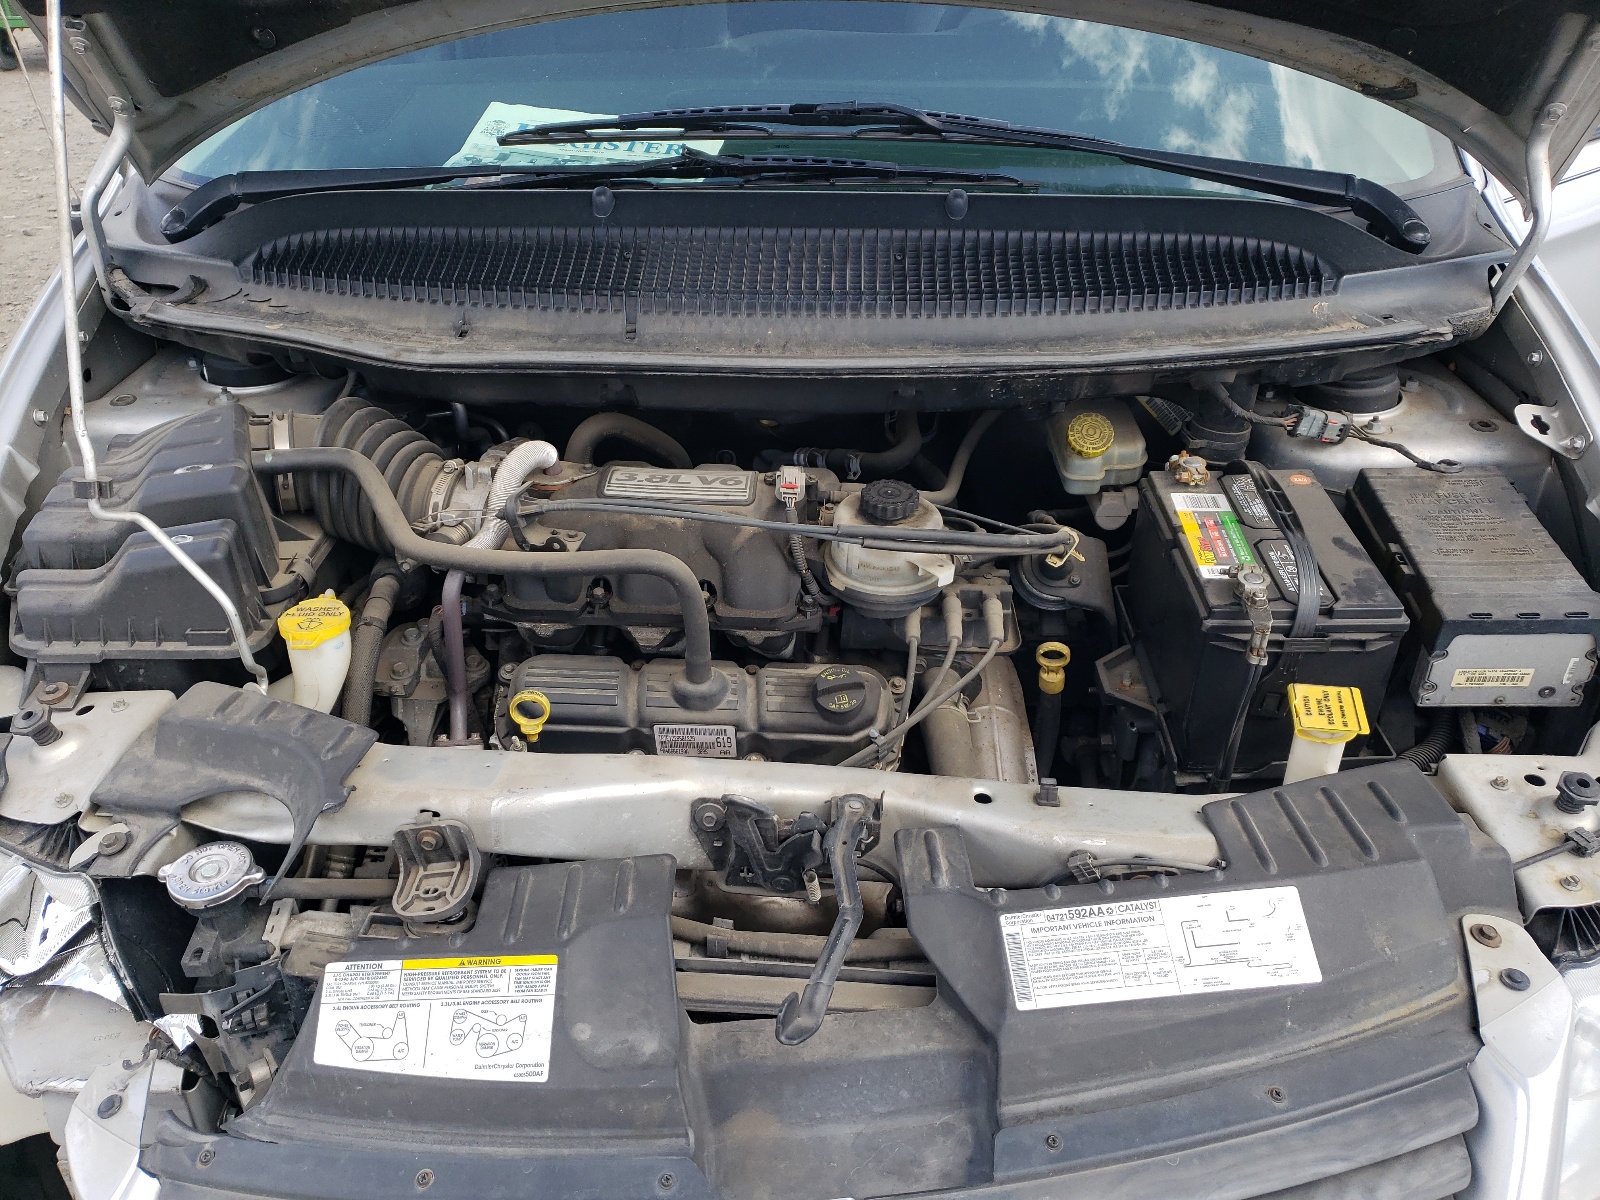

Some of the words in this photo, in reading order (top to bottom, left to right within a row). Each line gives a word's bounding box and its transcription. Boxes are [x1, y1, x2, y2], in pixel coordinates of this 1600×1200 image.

[555, 139, 682, 155] GISTER
[615, 472, 691, 485] 3.8L
[697, 475, 743, 486] V6
[716, 737, 733, 748] 619
[1046, 907, 1105, 922] 04721592AA
[1118, 901, 1157, 912] CATALYST
[1031, 924, 1072, 934] IMPORTANT
[1073, 920, 1103, 930] VEHICLE
[1104, 916, 1155, 926] INFORMATION
[466, 958, 501, 966] WARNING
[515, 1061, 544, 1069] Corporation
